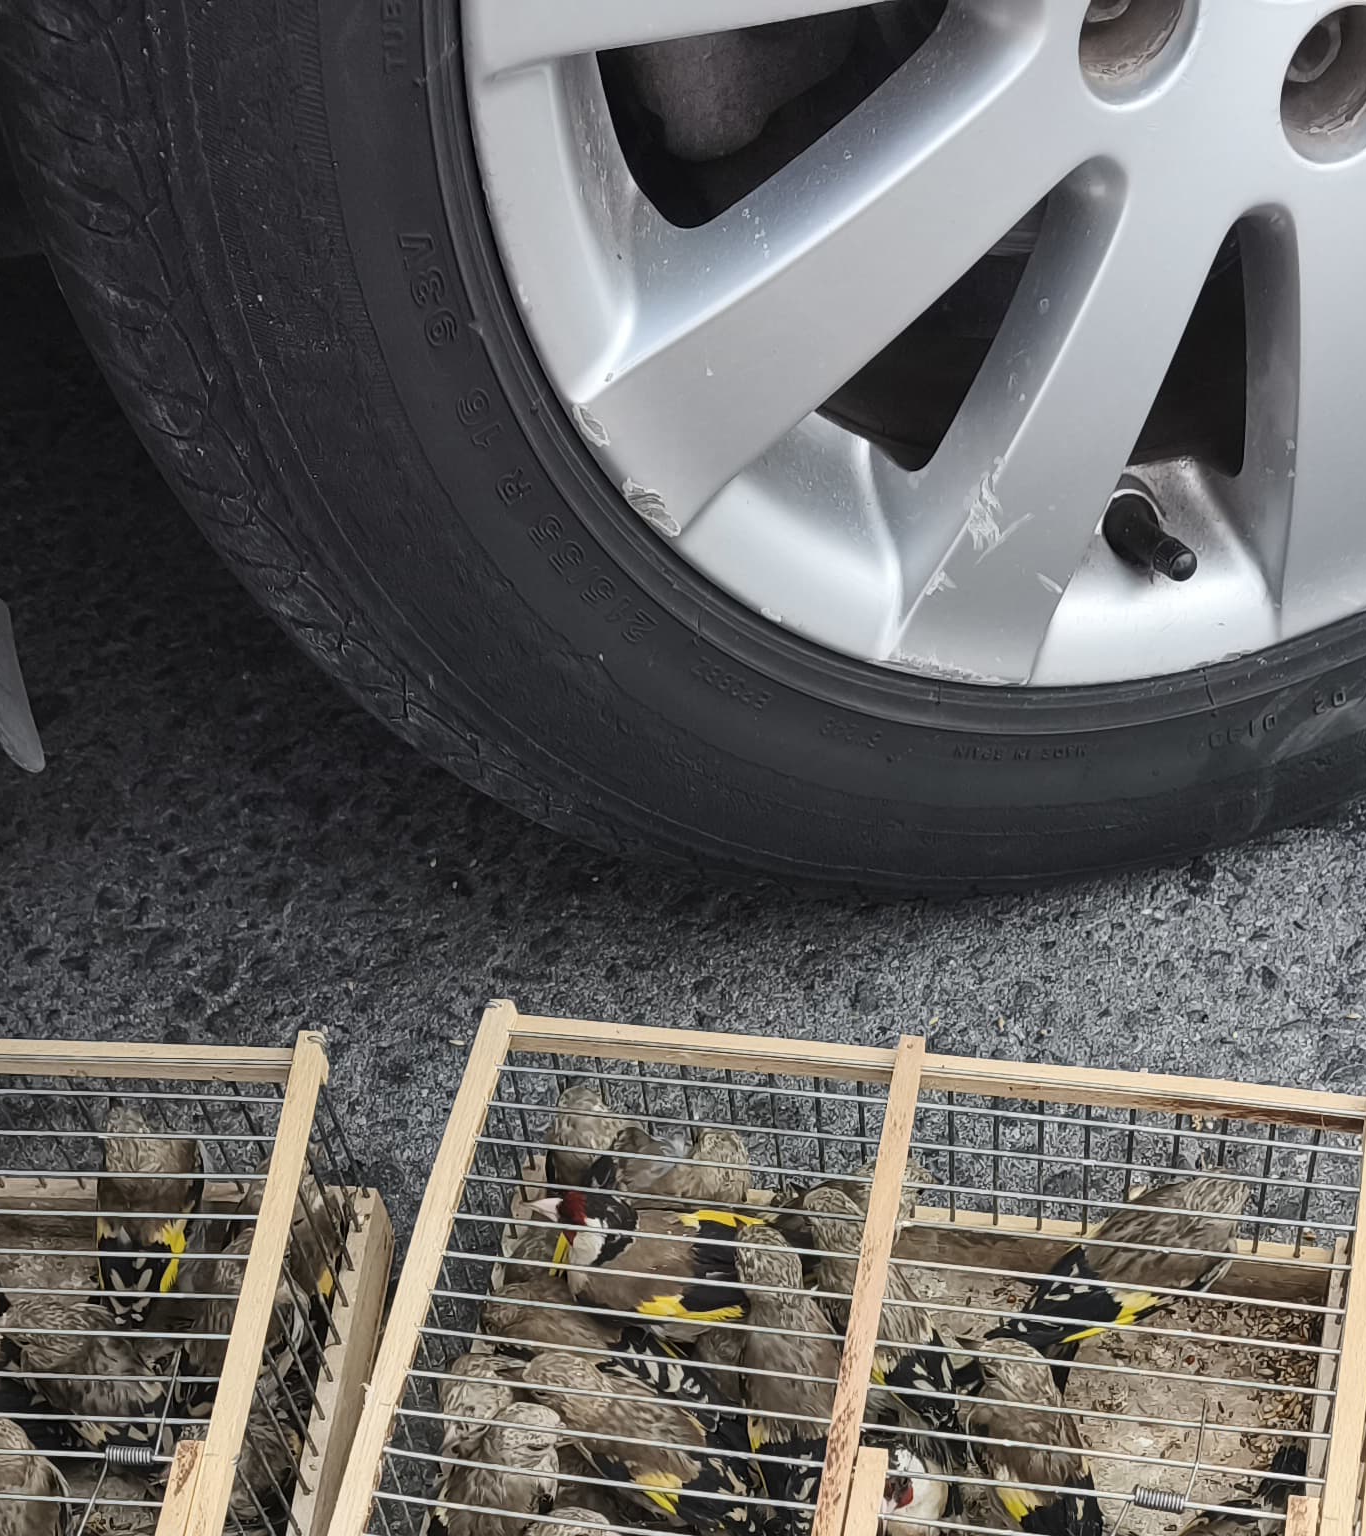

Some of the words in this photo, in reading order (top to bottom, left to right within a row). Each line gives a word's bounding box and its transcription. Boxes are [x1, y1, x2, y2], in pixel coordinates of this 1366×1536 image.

[397, 231, 459, 350] 93V
[455, 387, 502, 449] 16
[496, 465, 533, 505] R
[529, 513, 658, 643] 215/55
